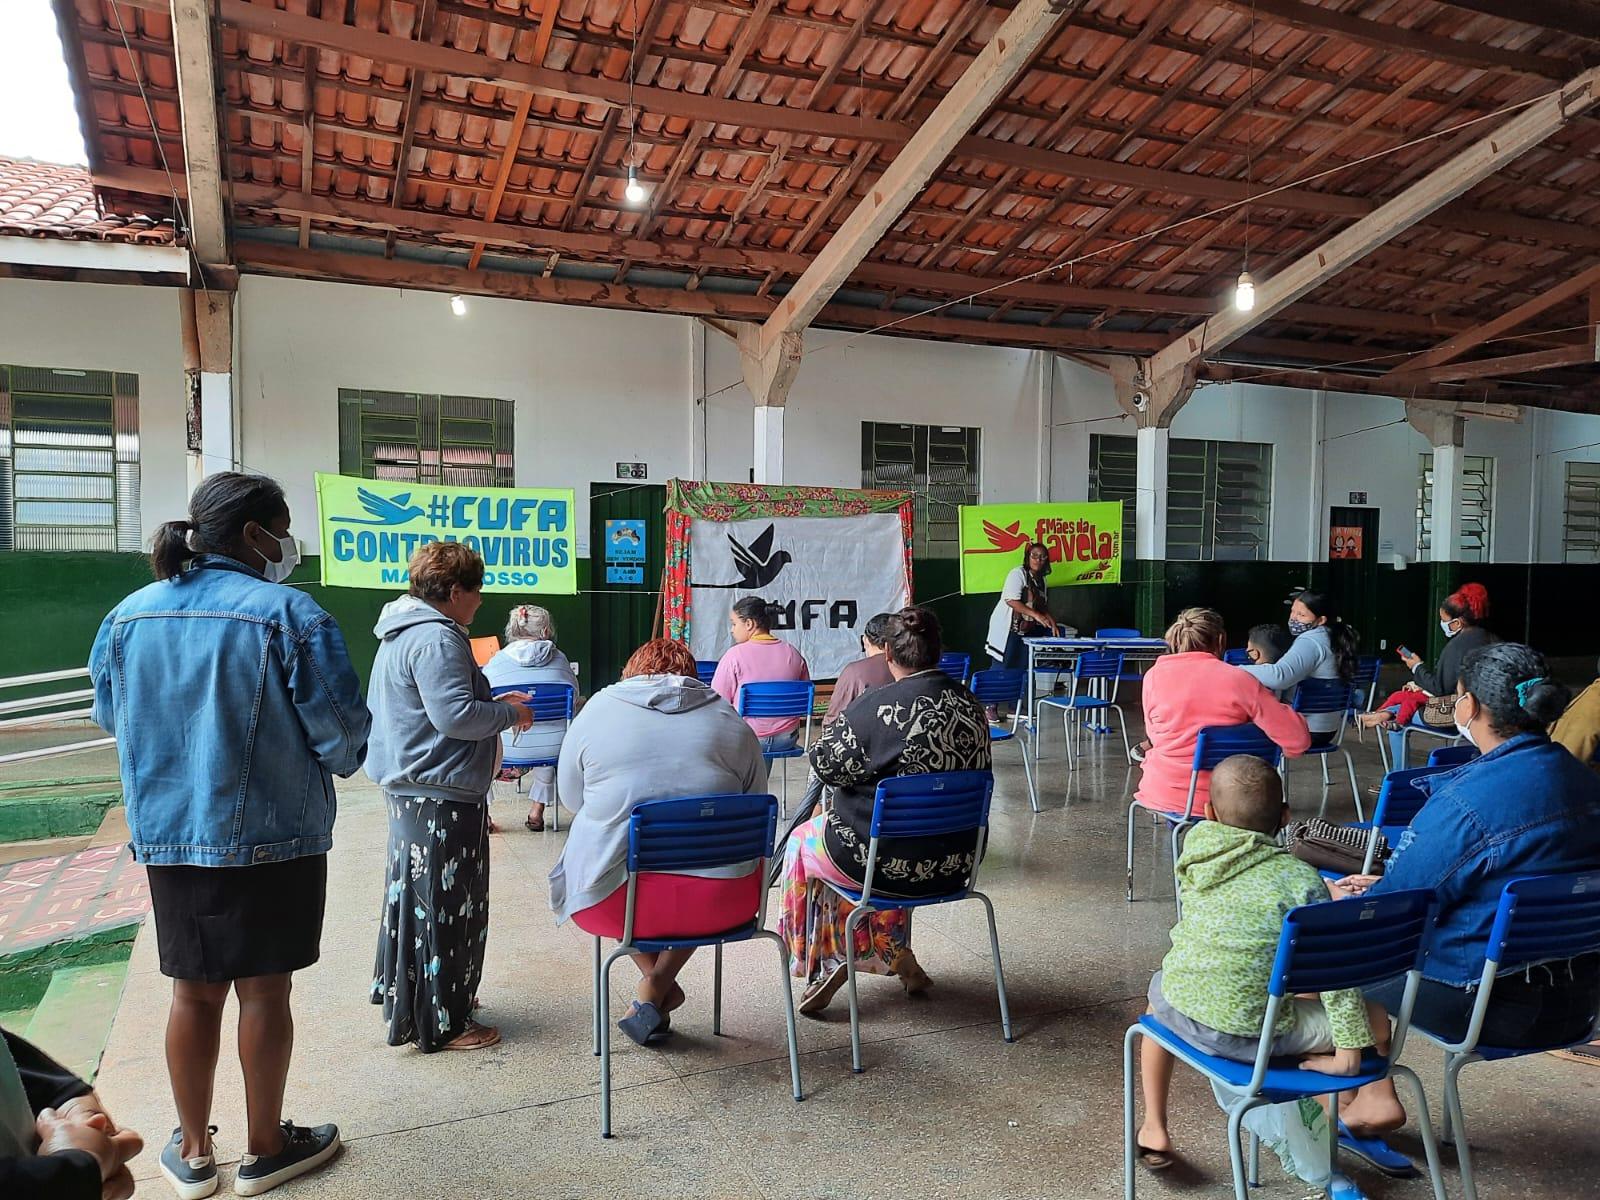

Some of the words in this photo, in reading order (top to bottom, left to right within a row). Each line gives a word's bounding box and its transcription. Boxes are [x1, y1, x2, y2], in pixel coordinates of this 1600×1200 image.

[630, 469, 645, 478] 02
[426, 494, 567, 532] #CUFA
[1046, 517, 1075, 534] Mães
[1076, 517, 1090, 533] da
[770, 599, 858, 630] UFA
